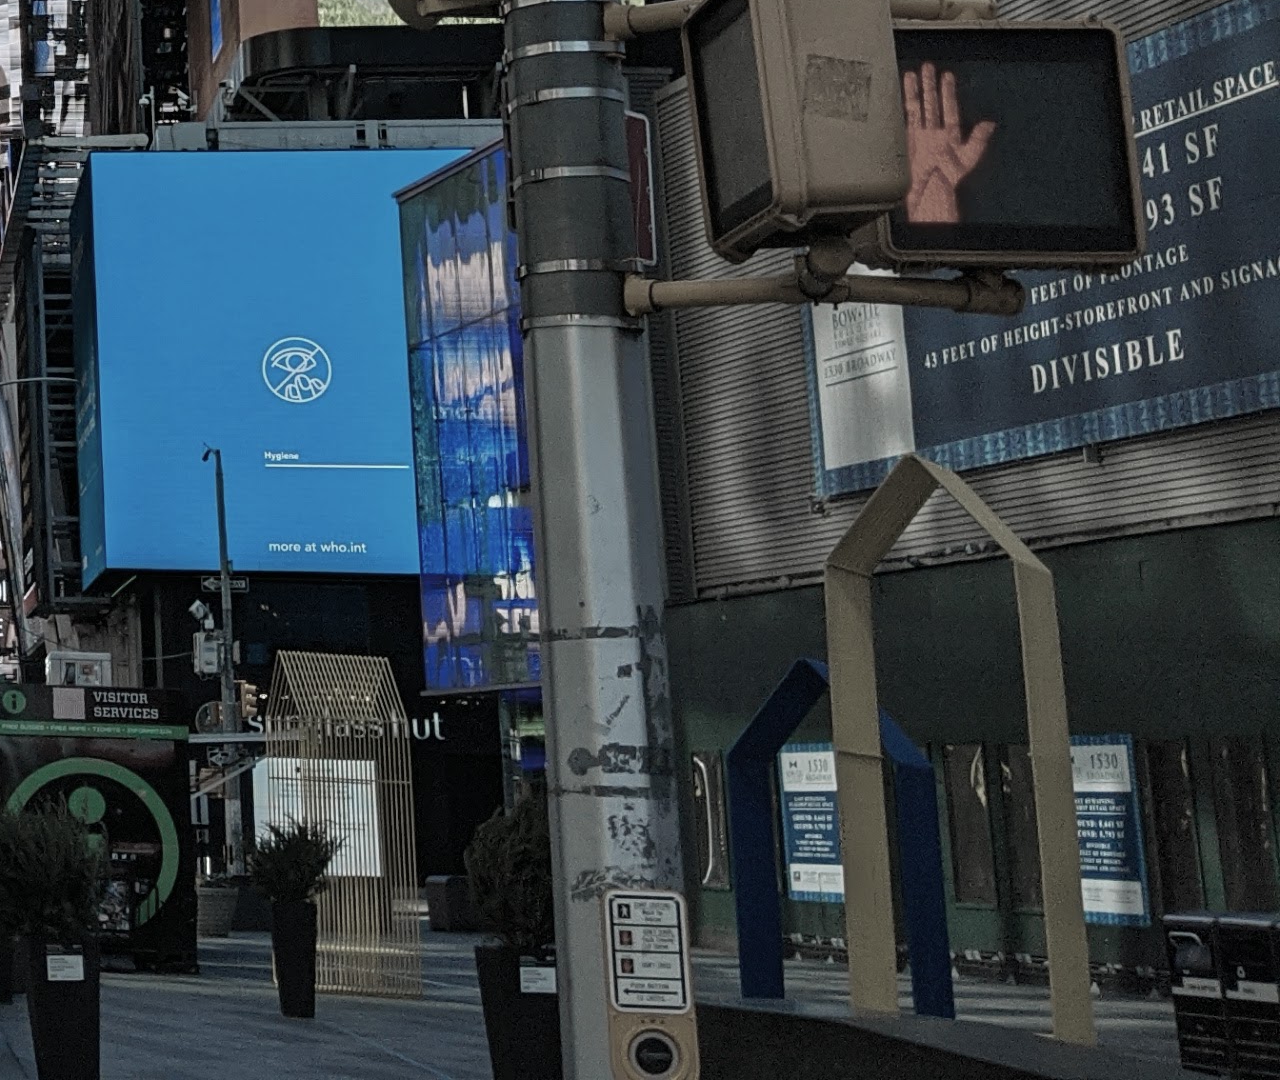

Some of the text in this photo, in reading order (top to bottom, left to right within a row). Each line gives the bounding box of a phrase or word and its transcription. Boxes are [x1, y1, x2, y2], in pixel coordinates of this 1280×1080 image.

[1140, 61, 1277, 131] RETAIL SPACE
[1142, 123, 1219, 179] 41 SF
[1145, 176, 1223, 231] 93 SF
[1030, 278, 1068, 306] FEET
[924, 351, 938, 369] 43
[942, 341, 975, 366] FEET
[980, 335, 999, 355] OF
[1004, 286, 1173, 348] HEIGHT-STOREFRONT
[1179, 277, 1215, 302] AND
[846, 348, 897, 372] BROADWAY
[1030, 328, 1185, 394] DIVISIBLE
[264, 451, 299, 462] Hygiene
[268, 540, 367, 555] more at who.int
[92, 691, 148, 705] VISITOR
[93, 707, 159, 720] SERVICES
[808, 758, 828, 773] 1530
[1090, 754, 1118, 770] 1530
